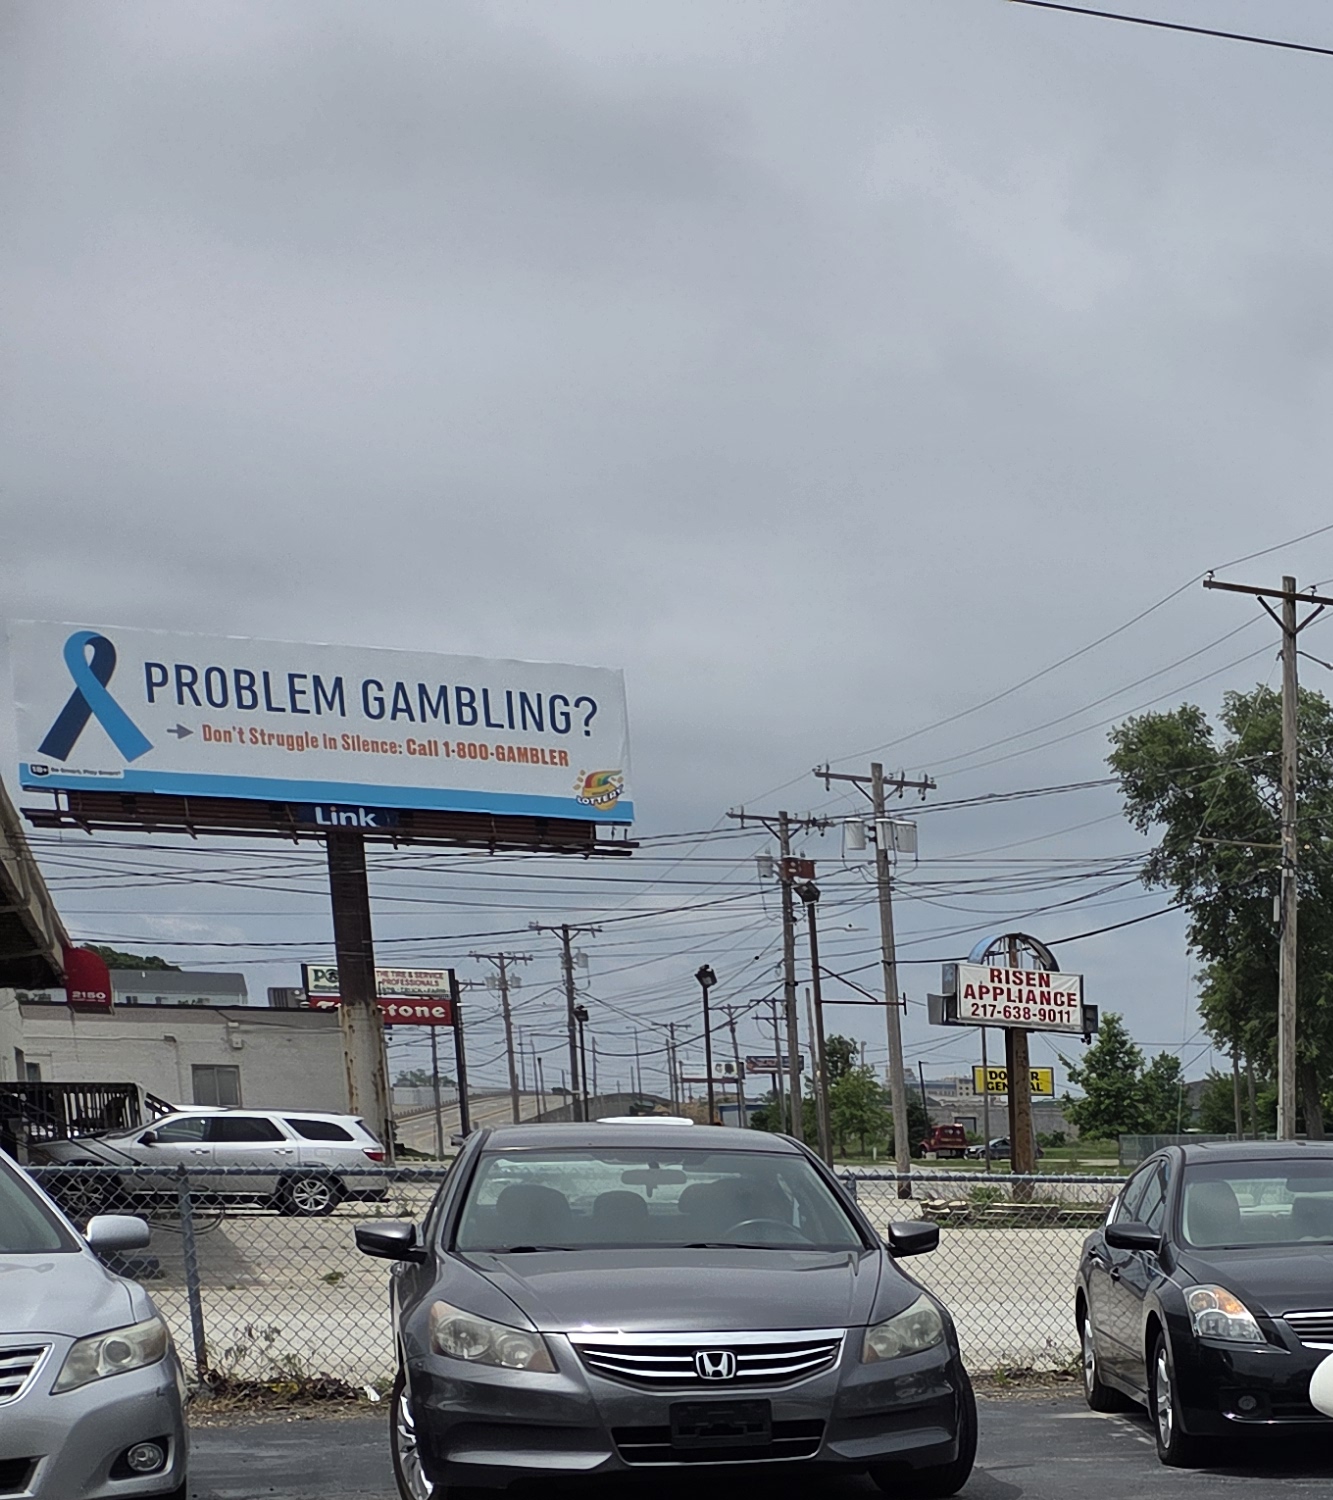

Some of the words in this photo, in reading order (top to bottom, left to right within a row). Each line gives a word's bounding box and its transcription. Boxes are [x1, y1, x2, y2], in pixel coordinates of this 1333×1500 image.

[144, 662, 347, 717] PROBLEM
[361, 679, 598, 737] GAMBLING?
[202, 724, 245, 744] Don't
[249, 726, 320, 752] Struggle
[341, 734, 403, 755] Silence:
[406, 738, 439, 758] Call
[442, 740, 570, 768] 1-800-GAMBLER
[576, 784, 624, 806] LOTTERY
[315, 806, 380, 828] Link
[990, 968, 1050, 988] RISEN
[963, 984, 1078, 1008] APPLIANCE
[971, 1002, 1071, 1024] 217-638-9011
[987, 1081, 1043, 1092] GENAL
[988, 1070, 1039, 1081] DOR
